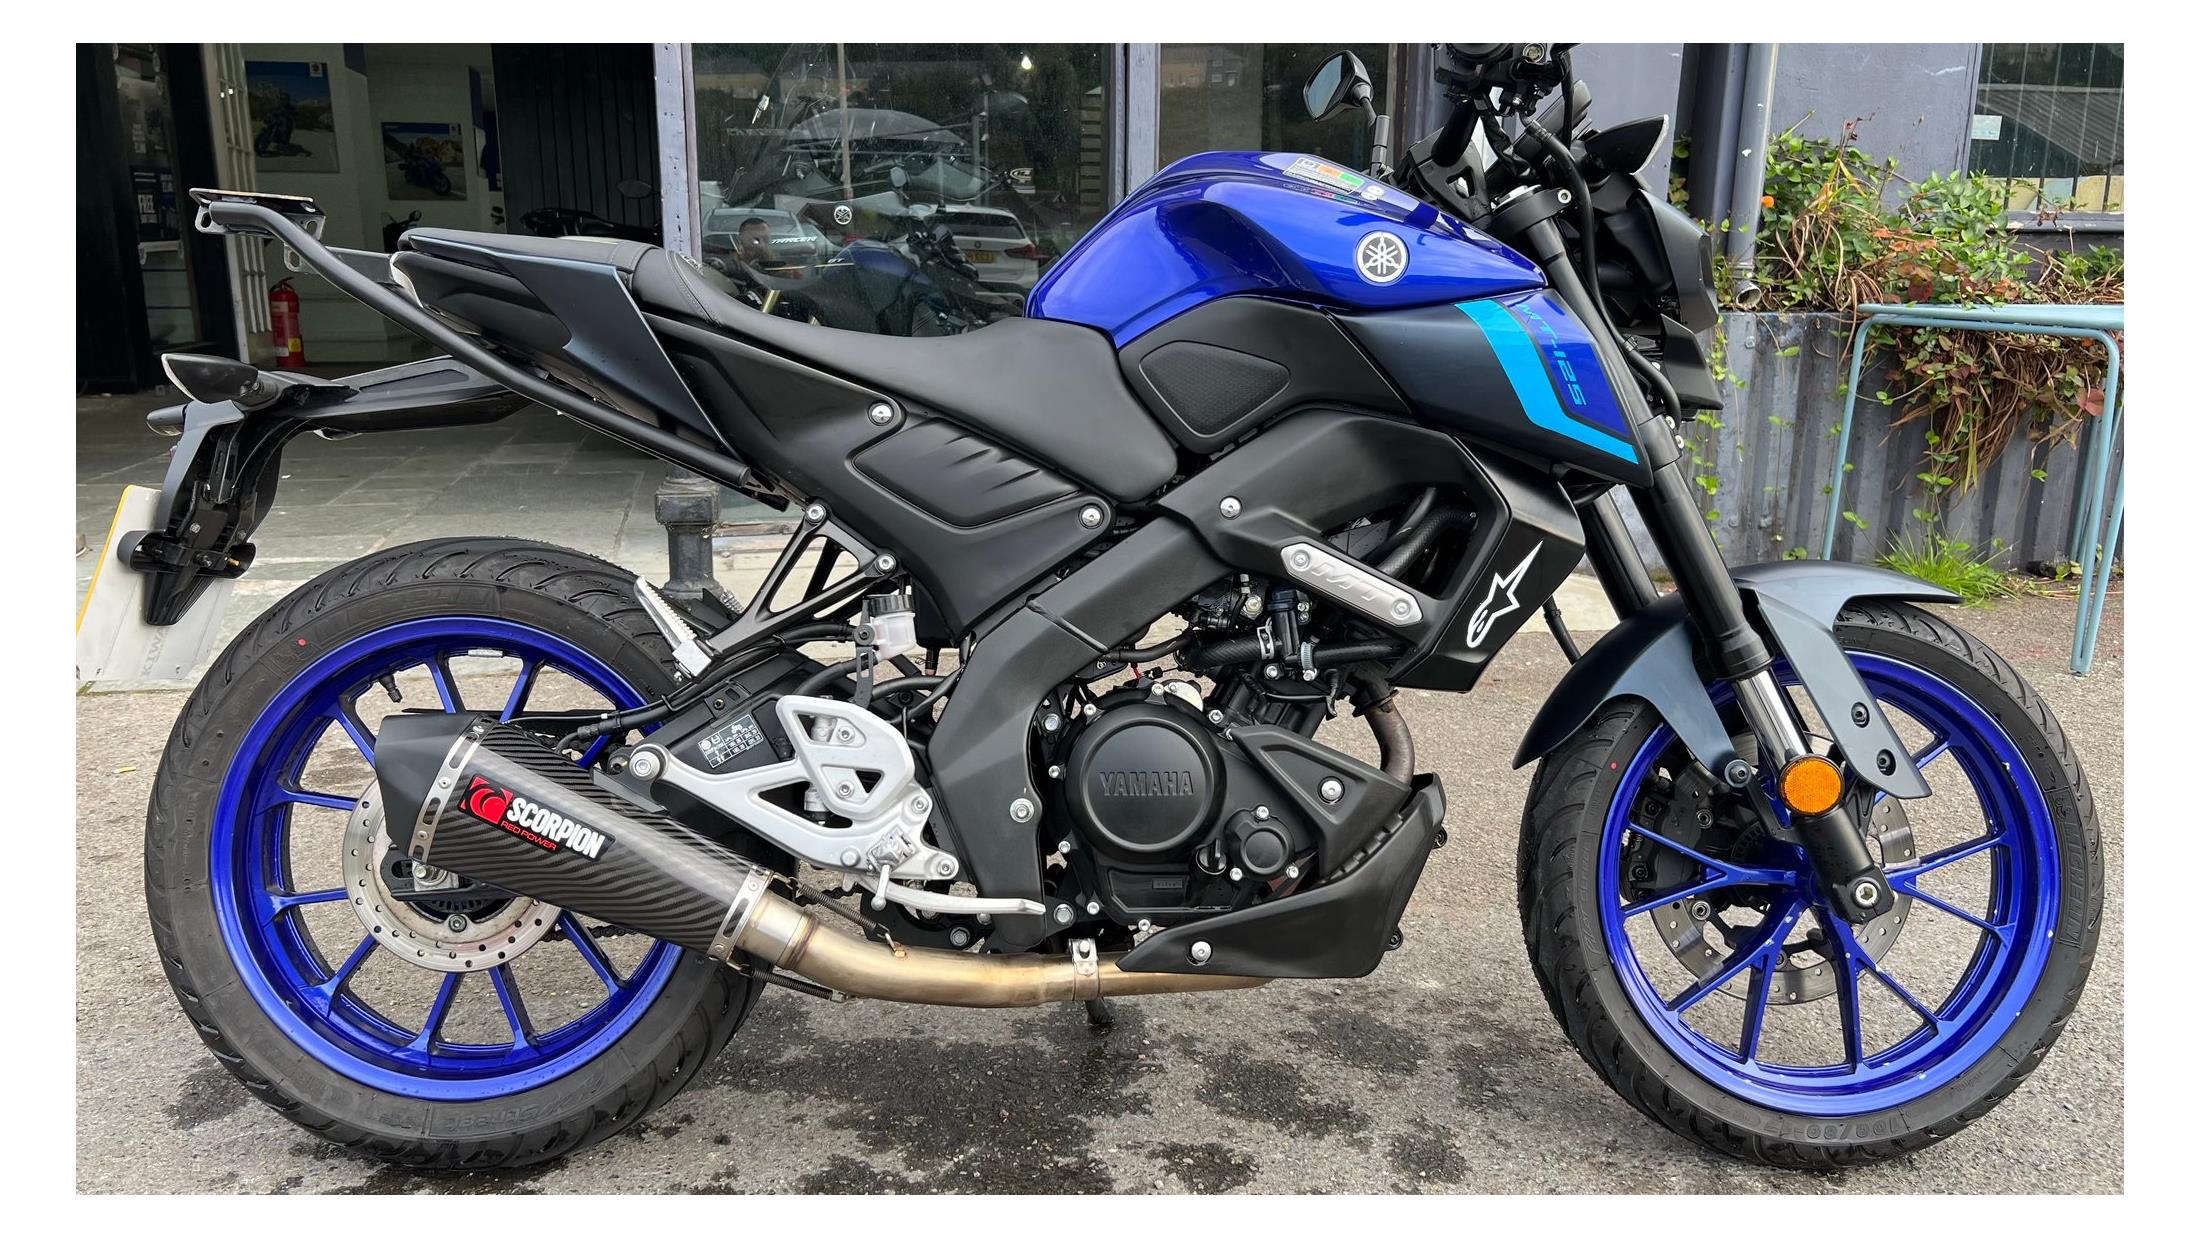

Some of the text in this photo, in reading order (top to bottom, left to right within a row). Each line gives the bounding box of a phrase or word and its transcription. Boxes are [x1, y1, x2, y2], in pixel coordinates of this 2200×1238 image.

[1513, 303, 1587, 406] MT-125
[1311, 562, 1395, 601] MT
[1099, 771, 1194, 796] YAMAHA
[500, 820, 557, 851] RED POWER
[506, 797, 606, 859] SCORPION
[2062, 820, 2085, 940] MICHELIN
